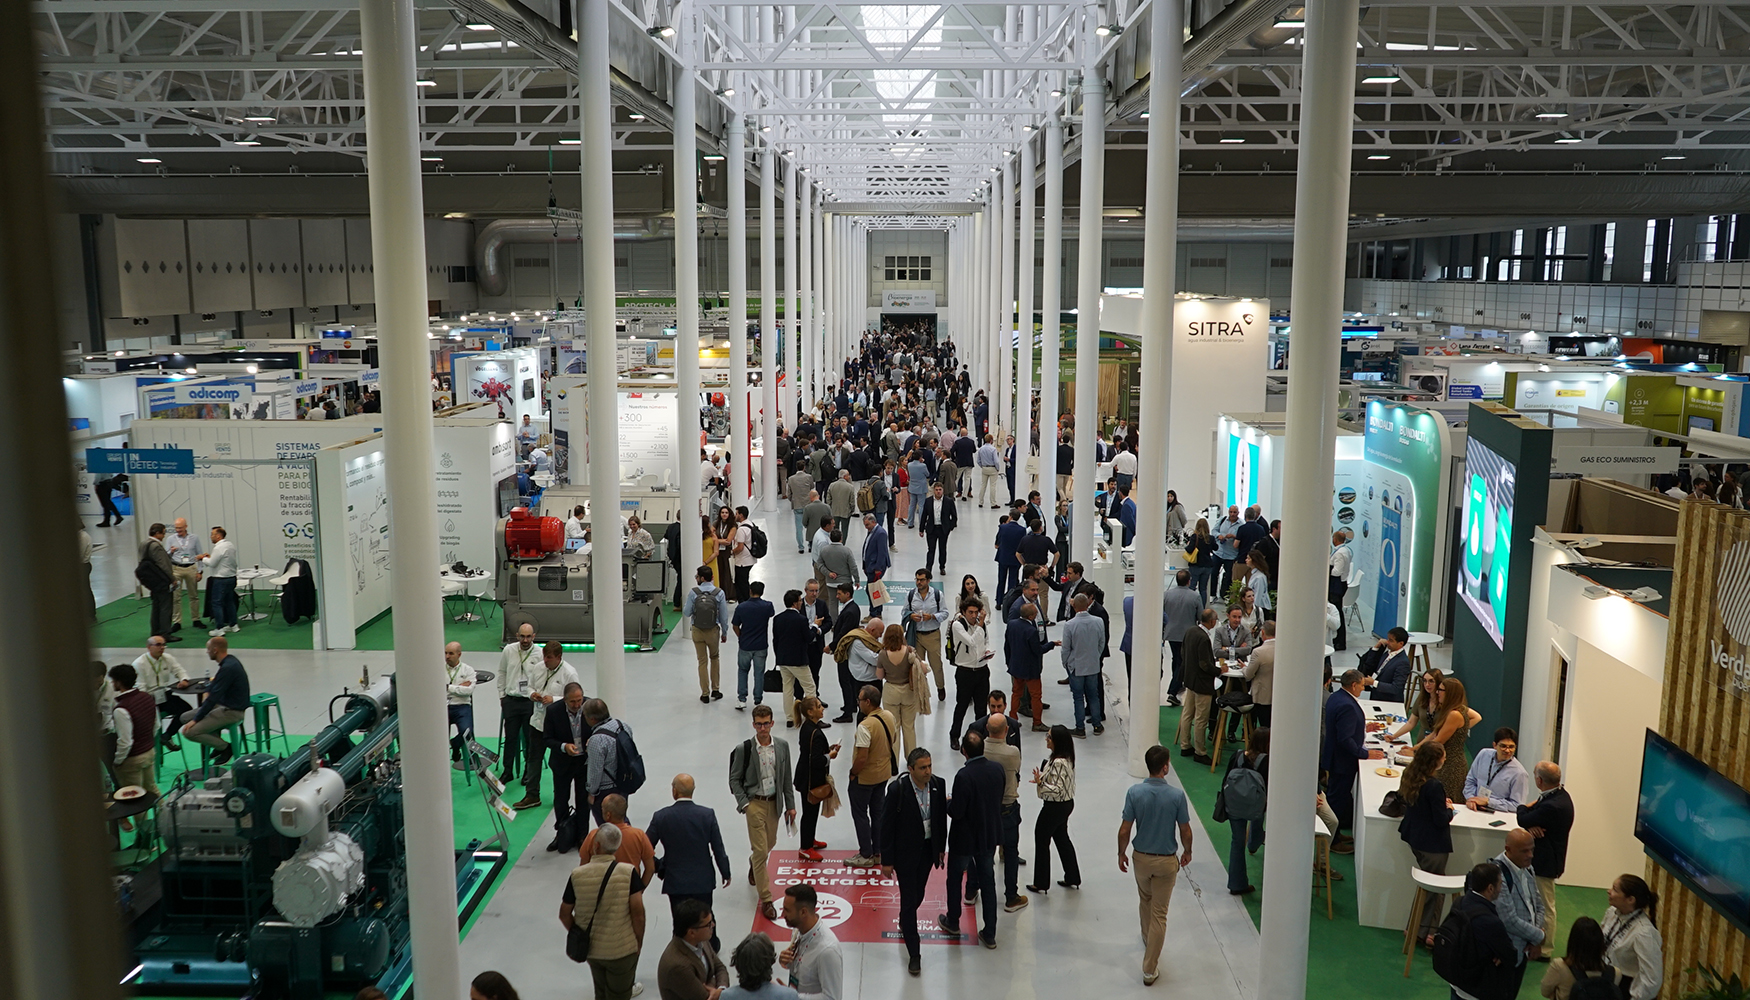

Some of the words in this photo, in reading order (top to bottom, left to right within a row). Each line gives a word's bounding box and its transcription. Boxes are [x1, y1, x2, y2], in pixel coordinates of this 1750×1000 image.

[1188, 321, 1244, 336] SITRA
[362, 370, 379, 382] adicomp
[296, 382, 318, 394] adicomp
[189, 386, 239, 402] adicomp
[619, 413, 642, 422] +300
[1399, 425, 1426, 442] BONDALTI
[276, 442, 320, 450] SISTEMAS
[130, 453, 140, 461] IN
[130, 461, 159, 470] DETEC
[279, 481, 290, 489] DE
[292, 481, 312, 489] BIOG
[288, 501, 312, 509] fracció
